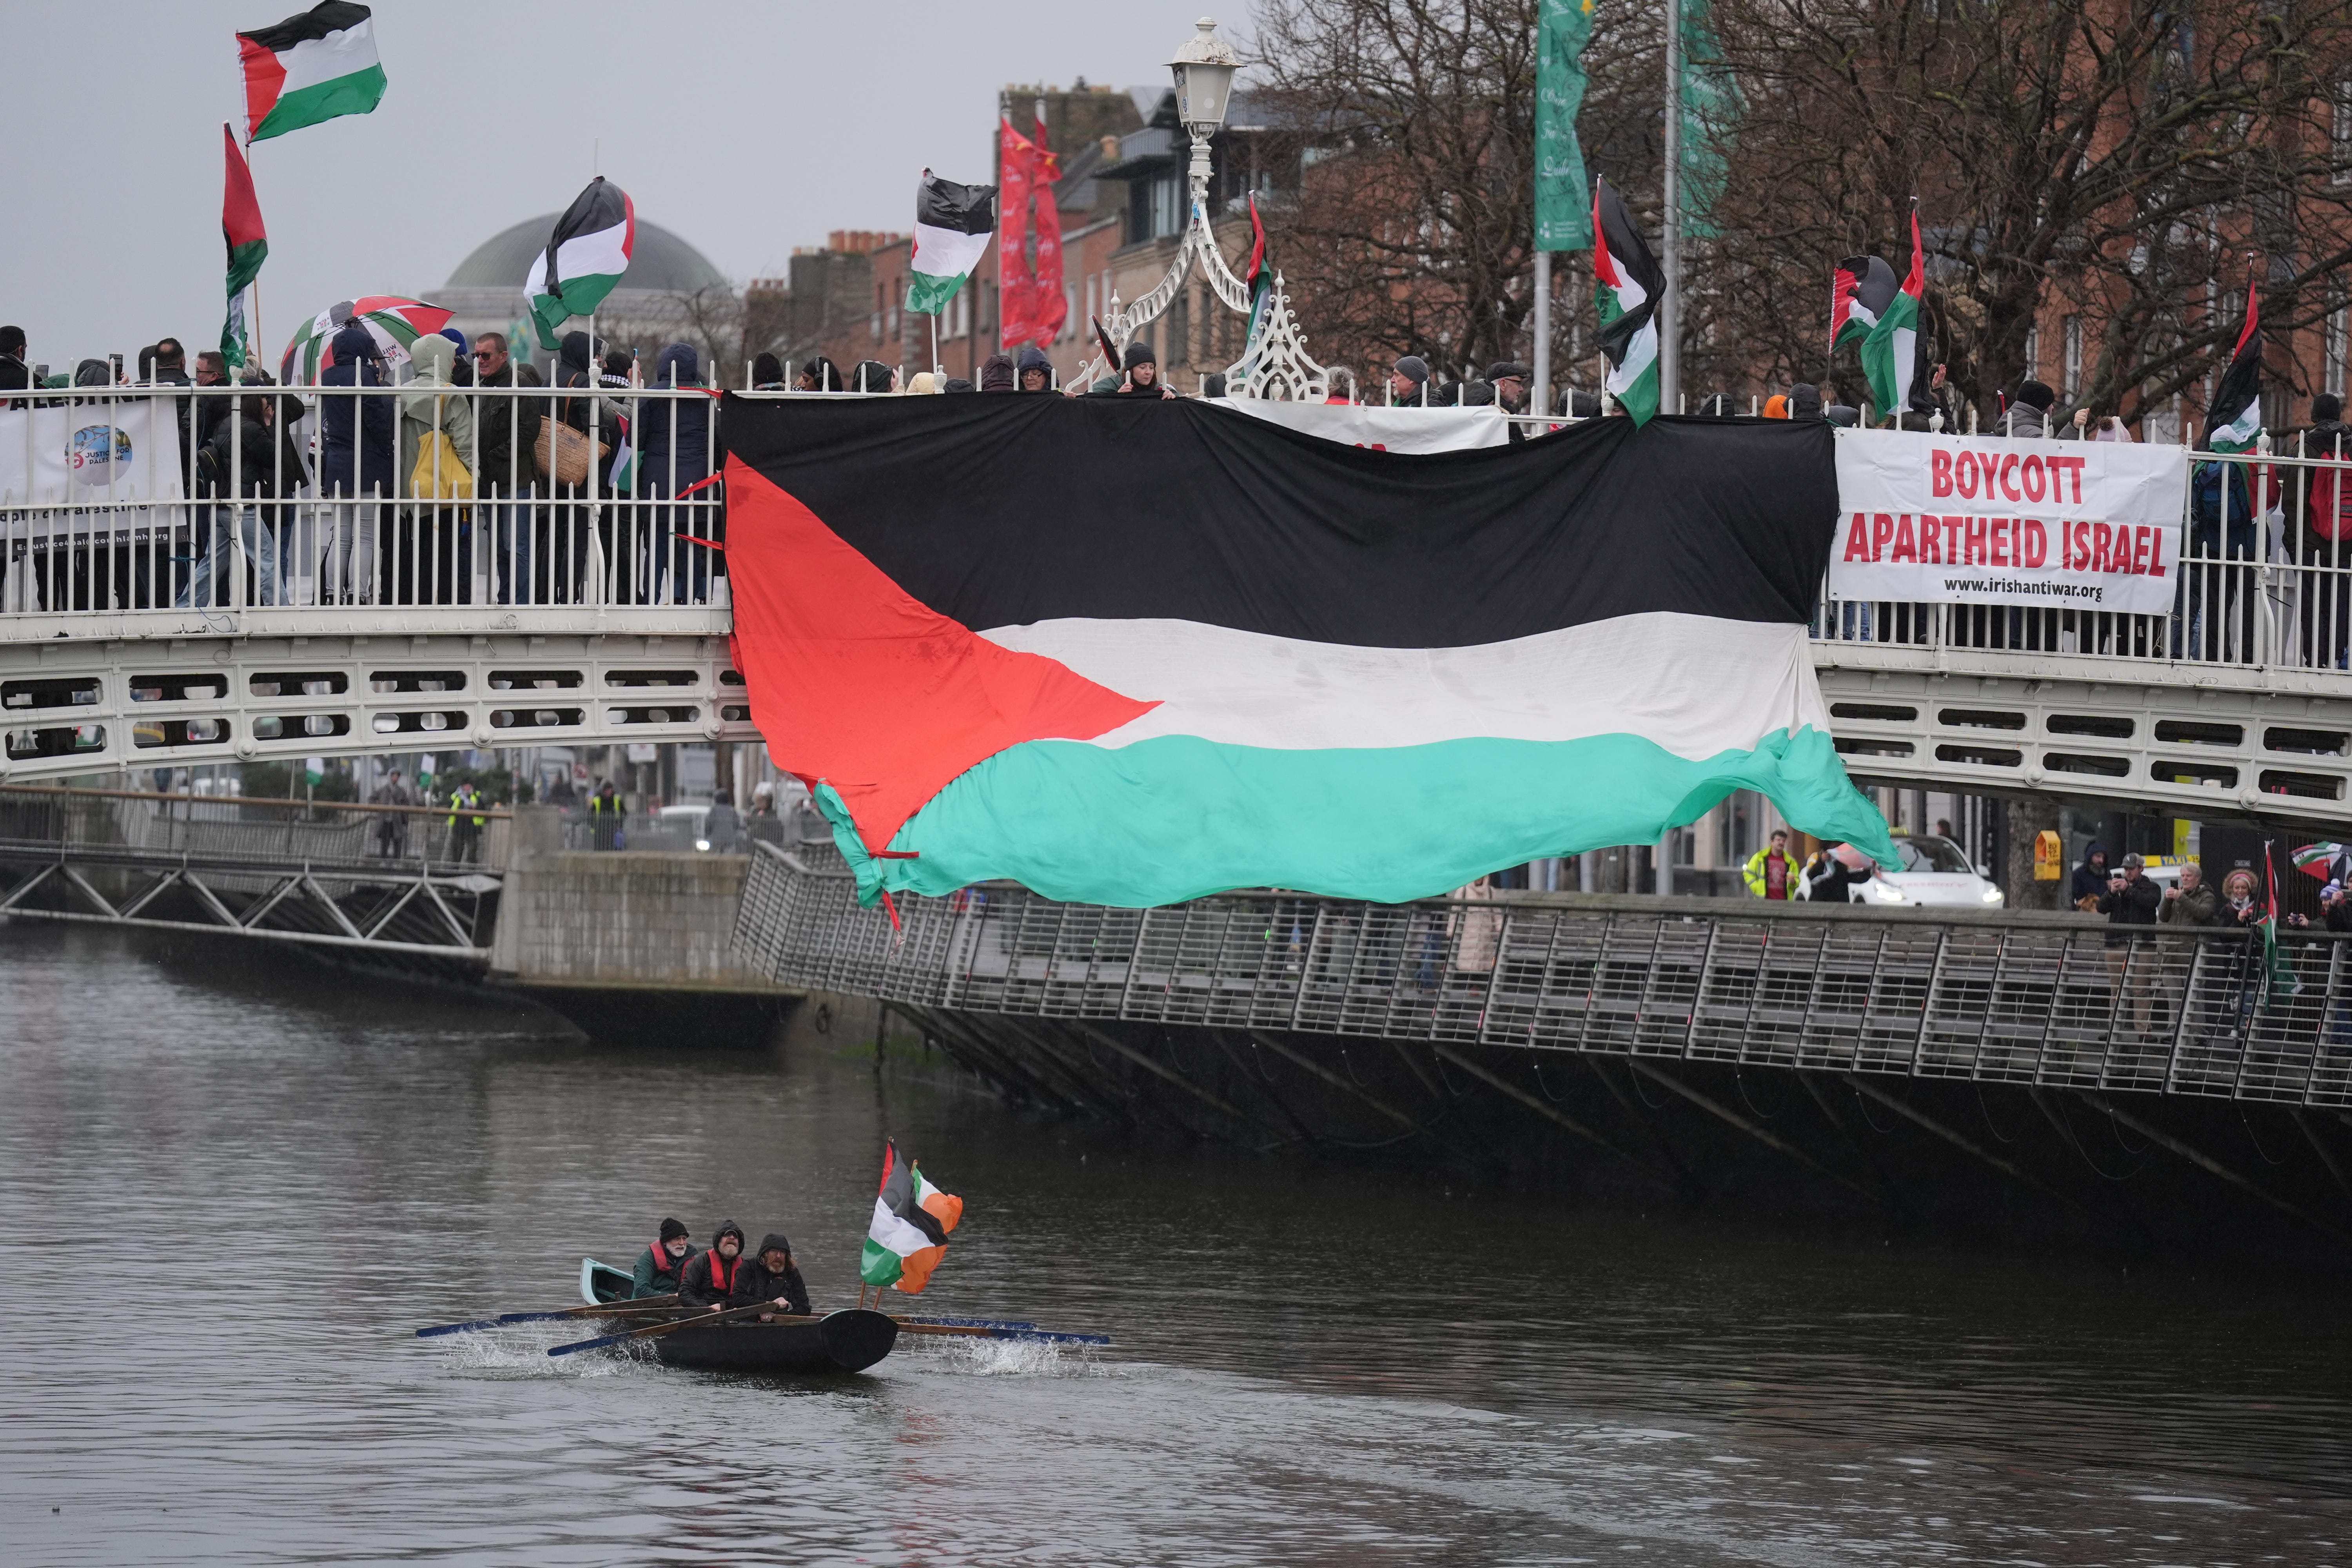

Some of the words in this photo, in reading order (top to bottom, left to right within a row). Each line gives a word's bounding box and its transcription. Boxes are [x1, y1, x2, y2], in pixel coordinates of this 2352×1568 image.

[89, 455, 123, 465] PALESNE
[1932, 450, 2085, 503] BOYCOTT
[64, 500, 147, 516] alesie
[1844, 513, 2047, 568] APARTHEID
[2063, 522, 2165, 576] ISRAEL
[1945, 577, 2102, 602] www.irishantiwar.org
[2162, 856, 2186, 866] TAXI
